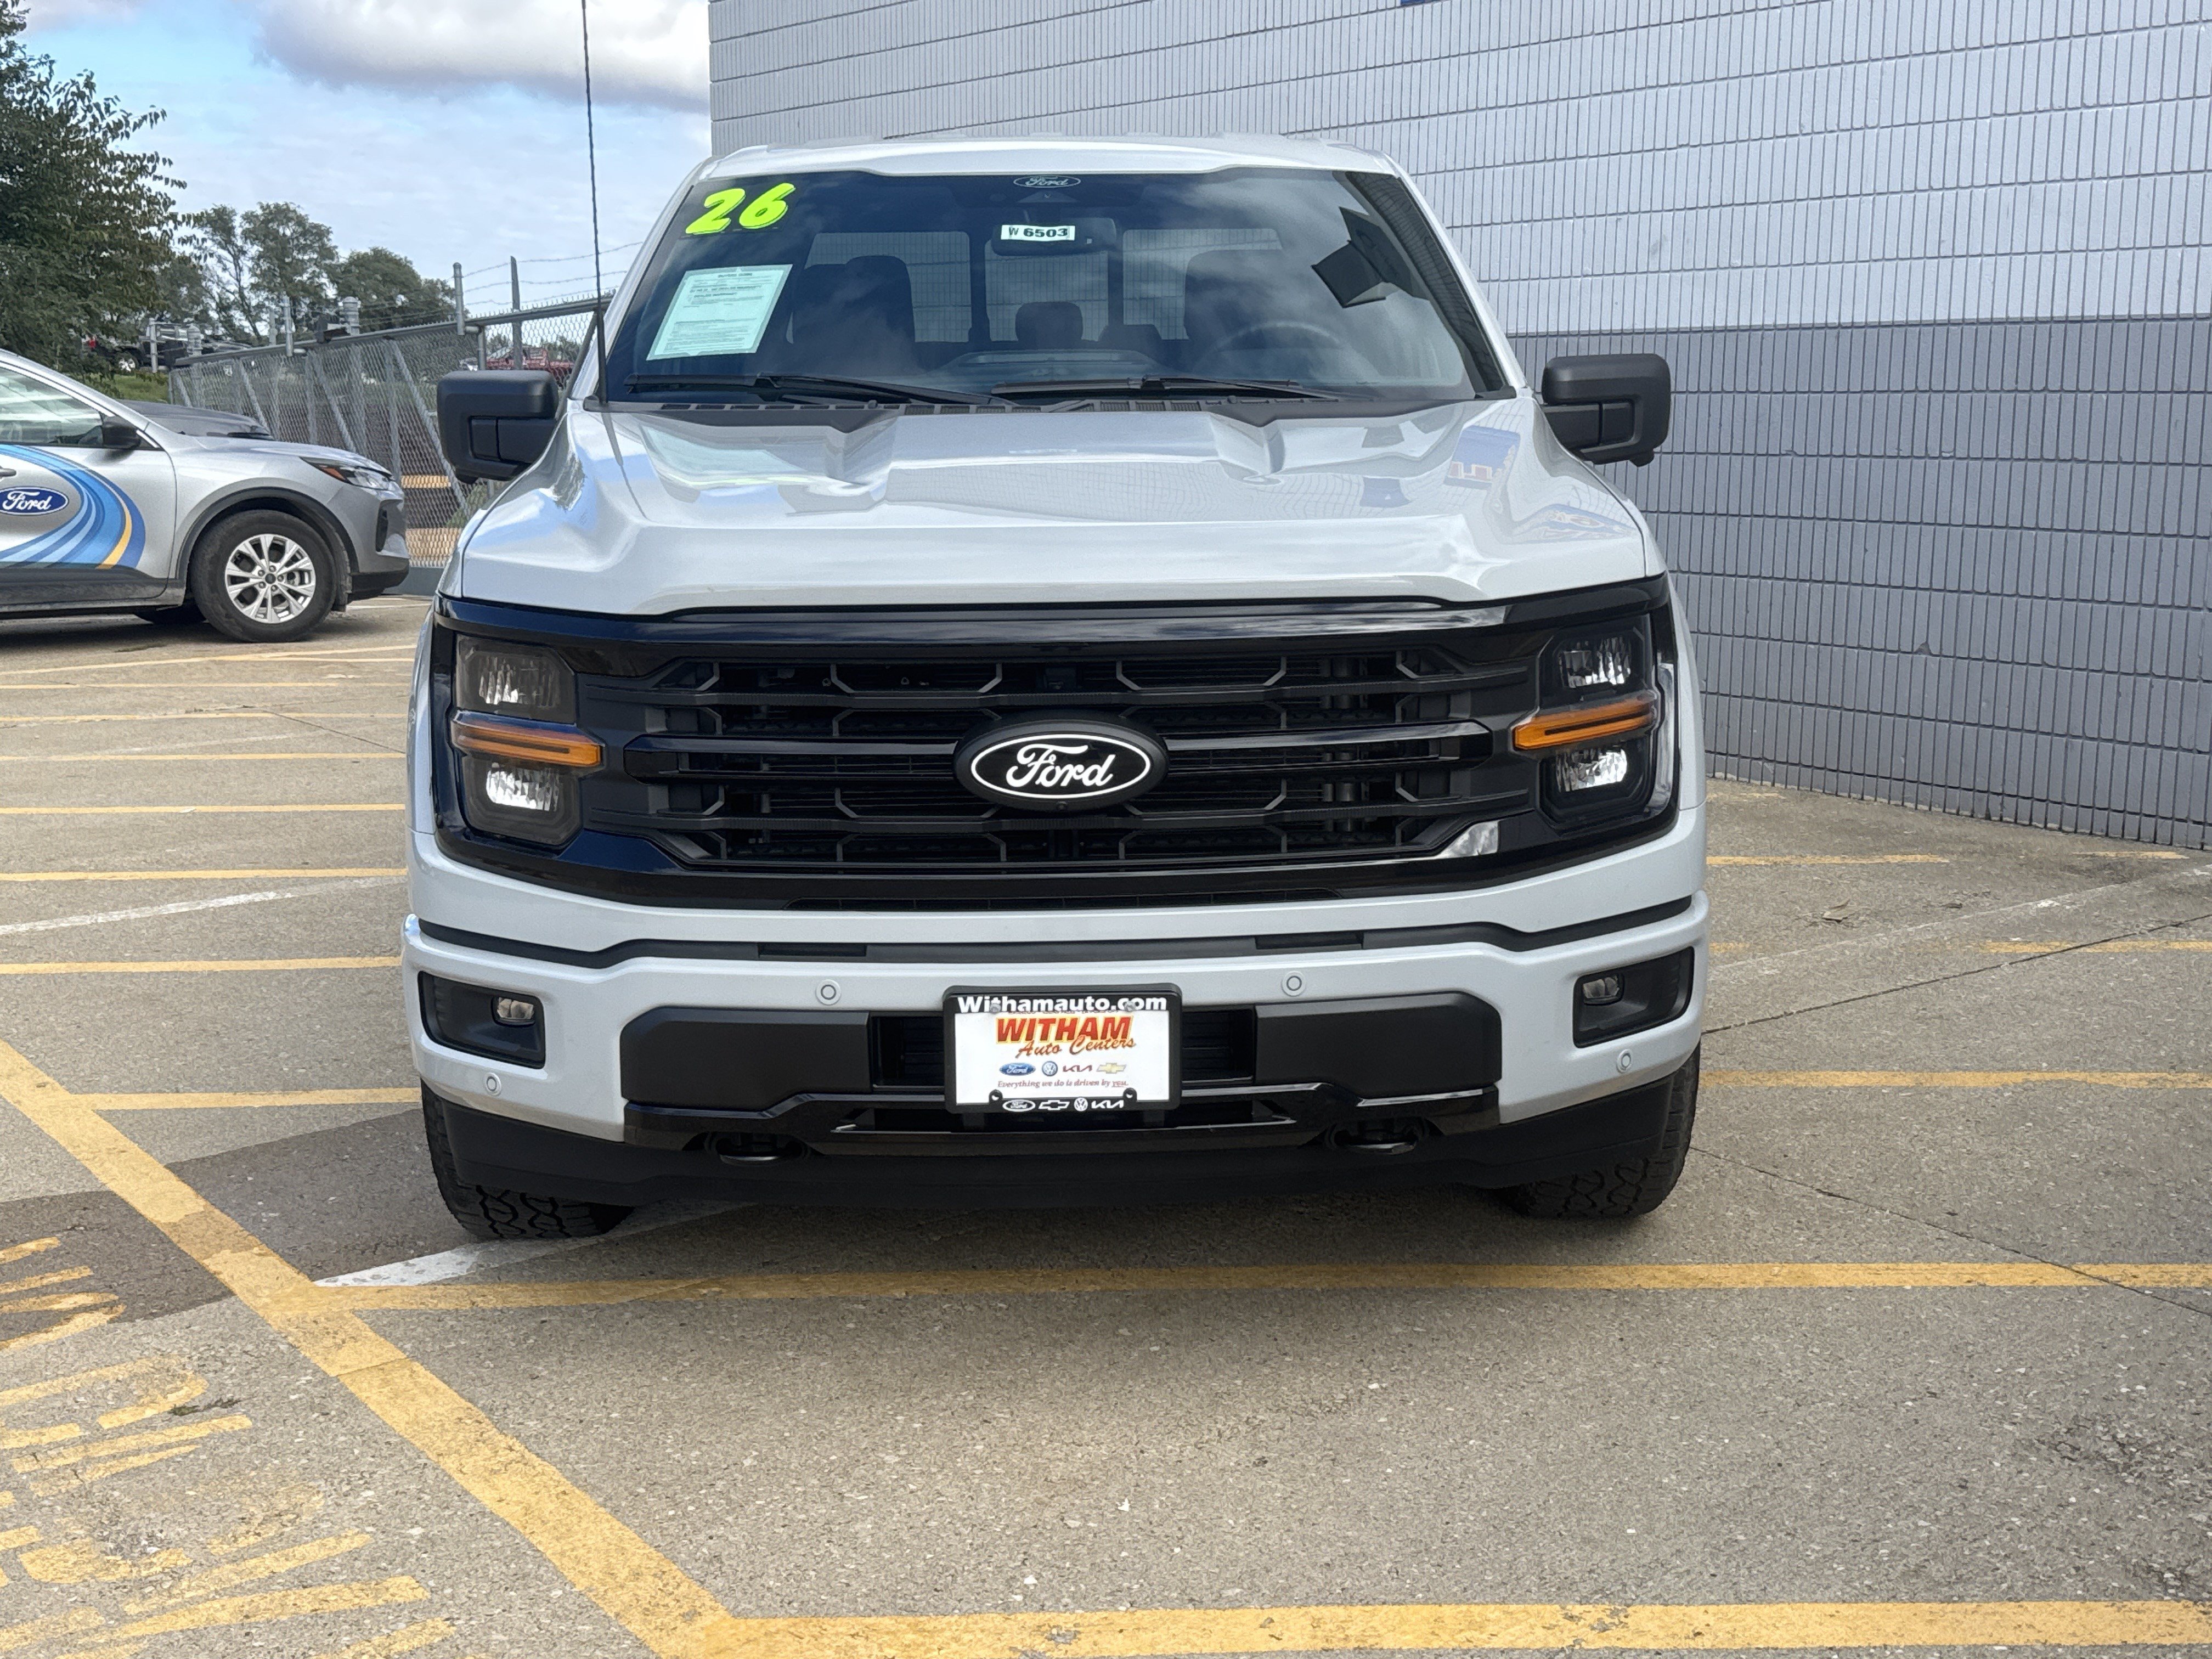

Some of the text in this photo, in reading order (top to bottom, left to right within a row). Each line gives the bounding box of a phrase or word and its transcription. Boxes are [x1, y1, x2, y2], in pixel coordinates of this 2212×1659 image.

[1024, 175, 1069, 186] Ford
[685, 183, 795, 235] 26
[1008, 226, 1068, 238] W 6503
[2, 490, 53, 510] Ford
[1005, 743, 1116, 788] Ford
[957, 995, 1167, 1013] Withamauto.com
[997, 1017, 1132, 1042] WITHAM
[1015, 1035, 1136, 1058] Auto Centers
[998, 1080, 1041, 1088] Everything
[1102, 1079, 1110, 1088] by
